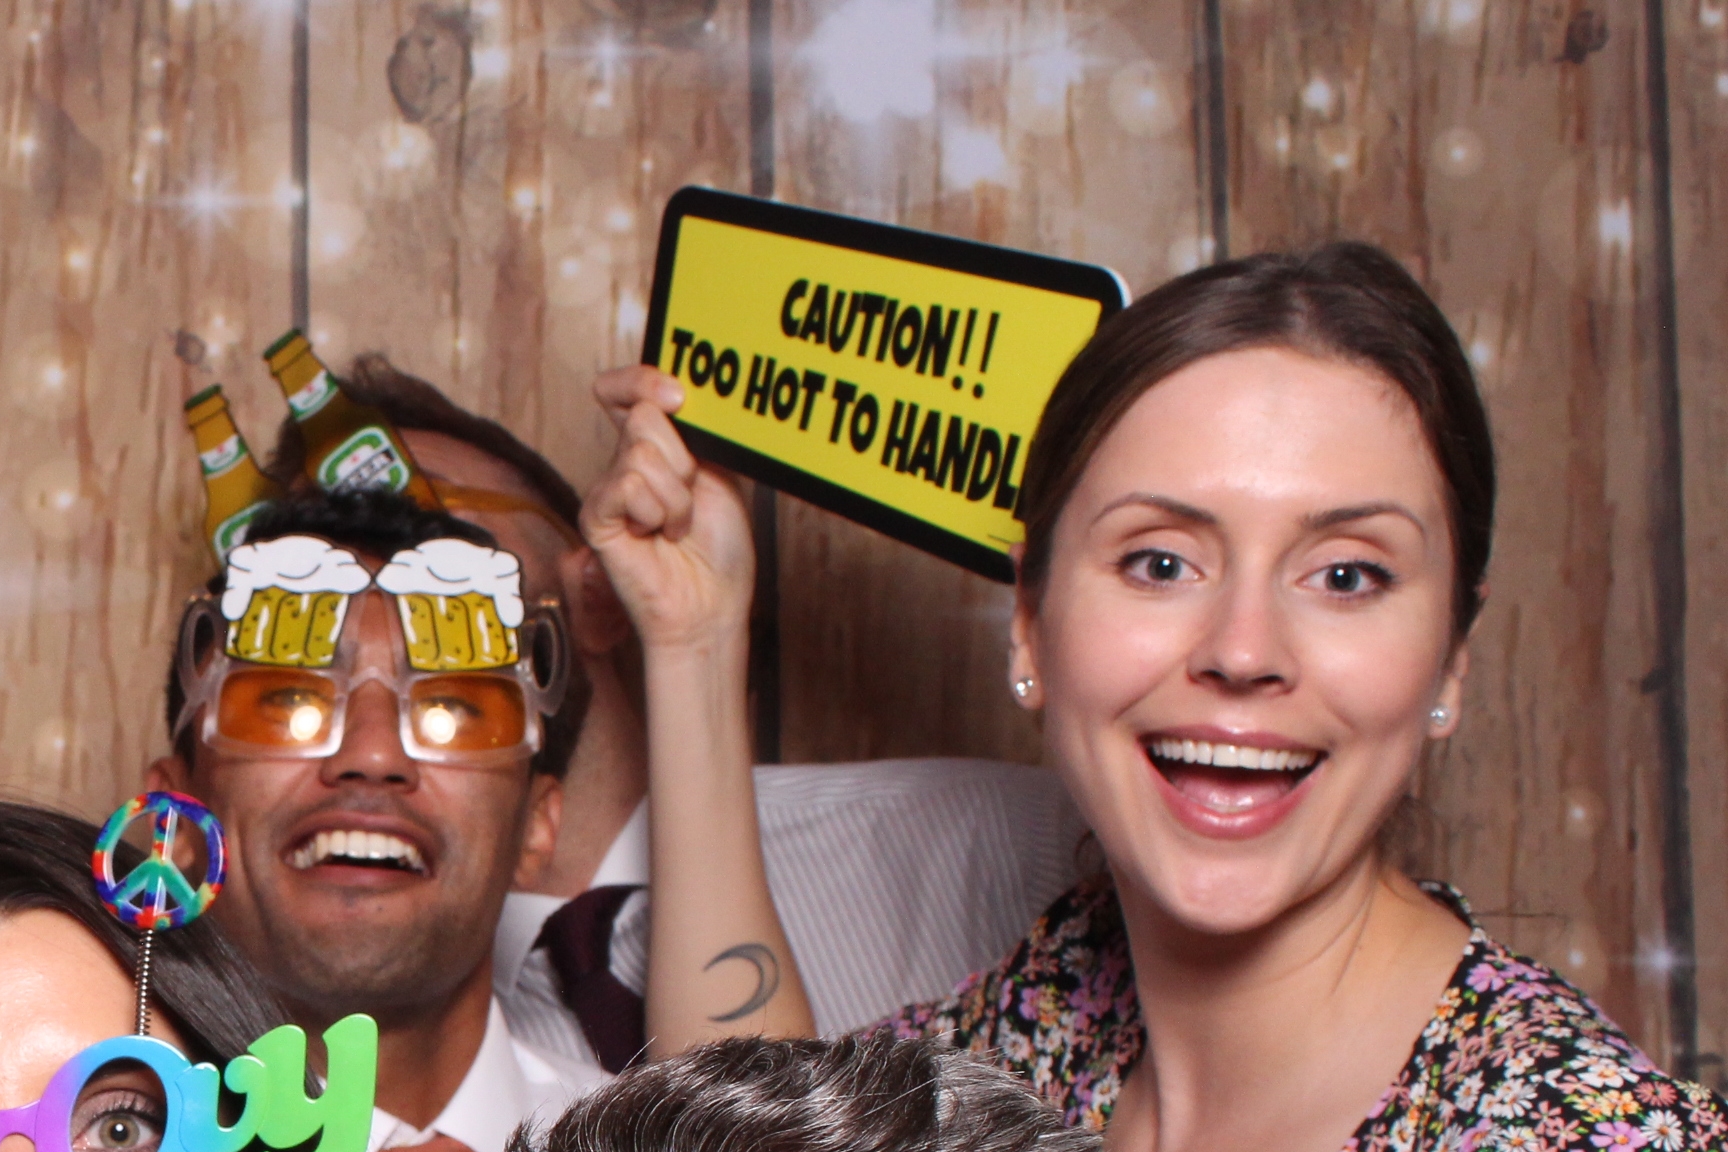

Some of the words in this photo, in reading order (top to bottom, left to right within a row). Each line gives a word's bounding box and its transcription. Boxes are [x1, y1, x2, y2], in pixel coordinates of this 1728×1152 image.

[781, 278, 1001, 399] CAUTION!!
[671, 328, 740, 398] TOO
[743, 354, 827, 431] HOT
[830, 379, 880, 453] TO
[880, 399, 1024, 519] HANDL
